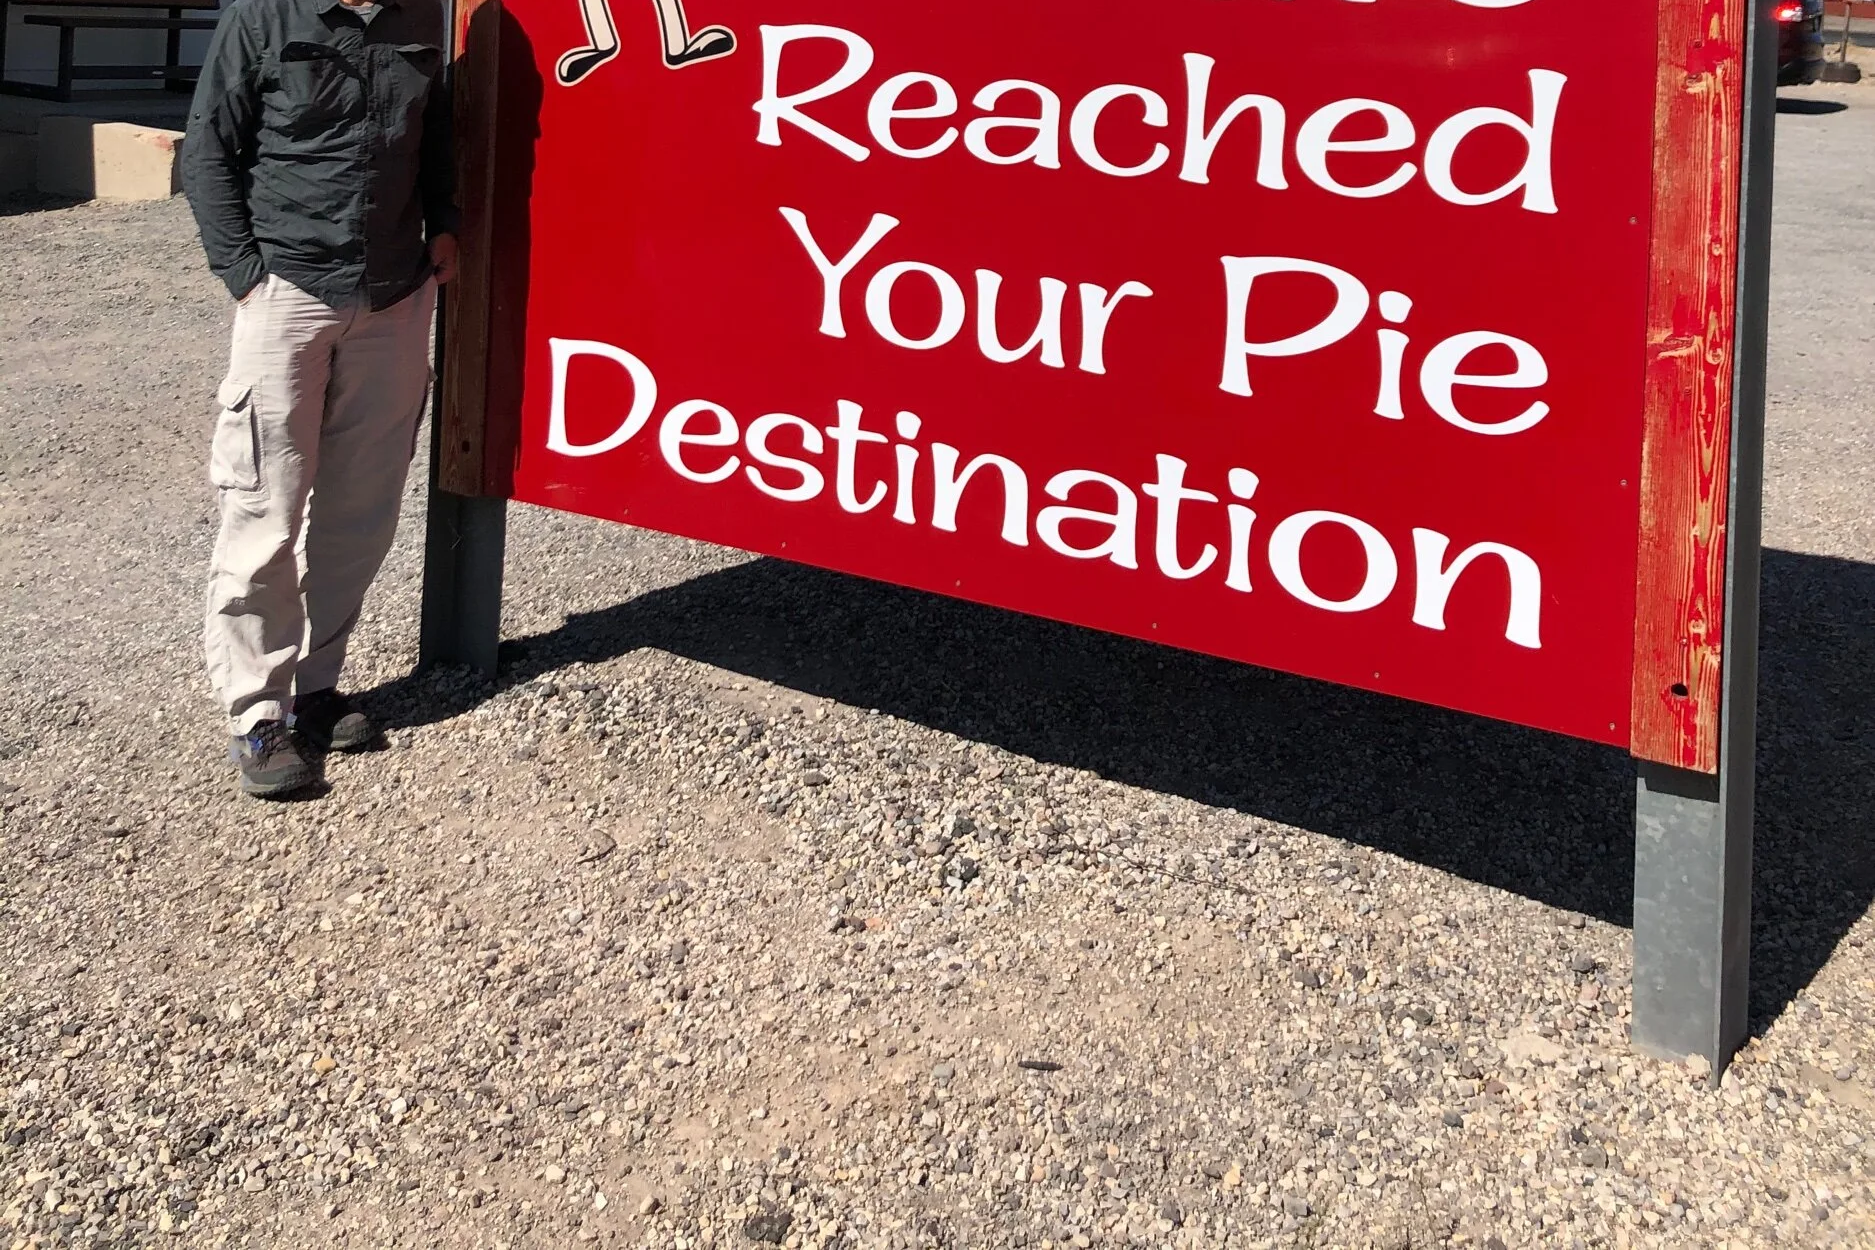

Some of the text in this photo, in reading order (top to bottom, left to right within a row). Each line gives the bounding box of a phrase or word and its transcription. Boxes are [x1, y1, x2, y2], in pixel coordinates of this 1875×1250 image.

[753, 25, 1567, 213] Reached
[779, 207, 1549, 434] Your Pie
[547, 338, 1541, 648] Destination
